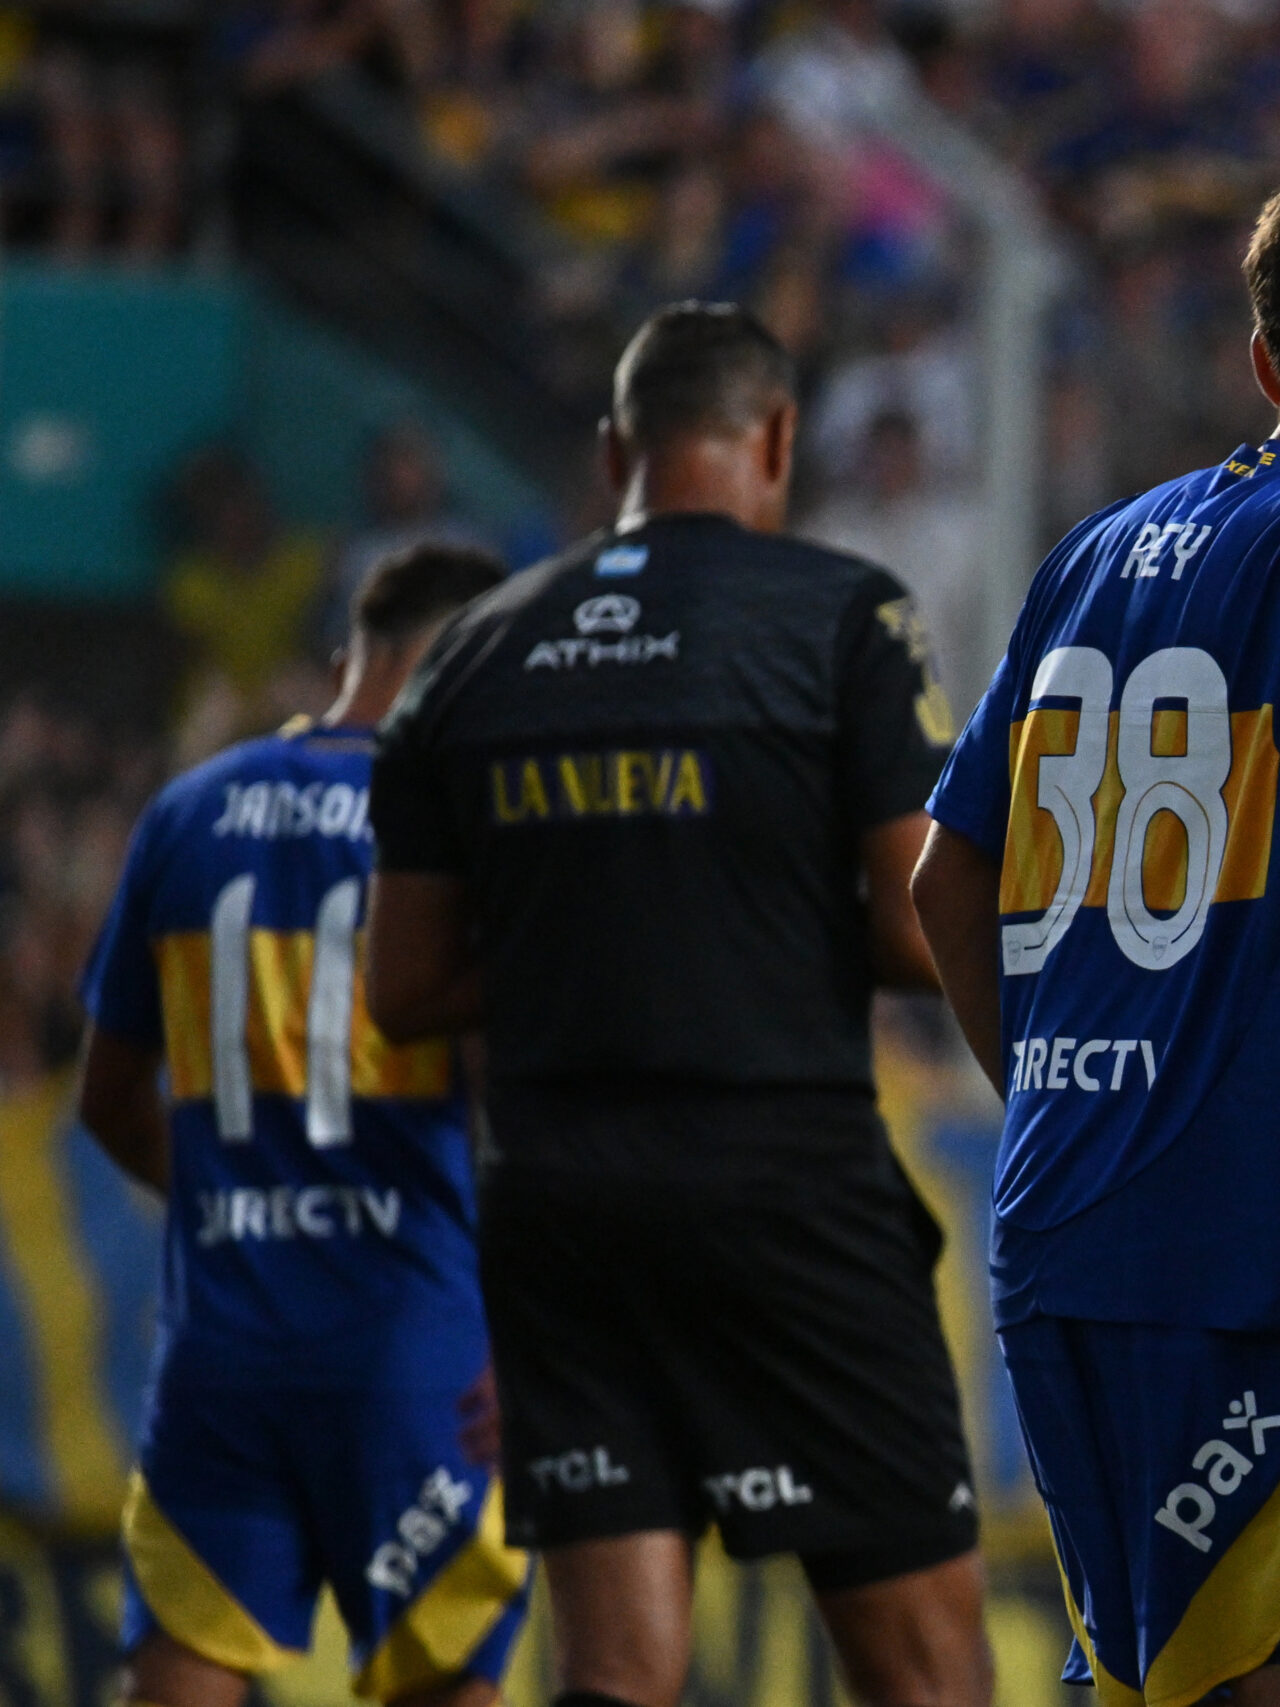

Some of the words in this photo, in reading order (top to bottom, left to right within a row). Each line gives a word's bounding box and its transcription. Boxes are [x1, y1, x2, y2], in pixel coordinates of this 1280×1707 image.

[1119, 522, 1213, 581] REY
[523, 629, 681, 671] ATHIX
[1001, 645, 1229, 975] 38
[209, 872, 361, 1150] 11
[528, 1446, 631, 1493] TCL
[703, 1466, 813, 1513] TCL
[366, 1466, 472, 1599] pax
